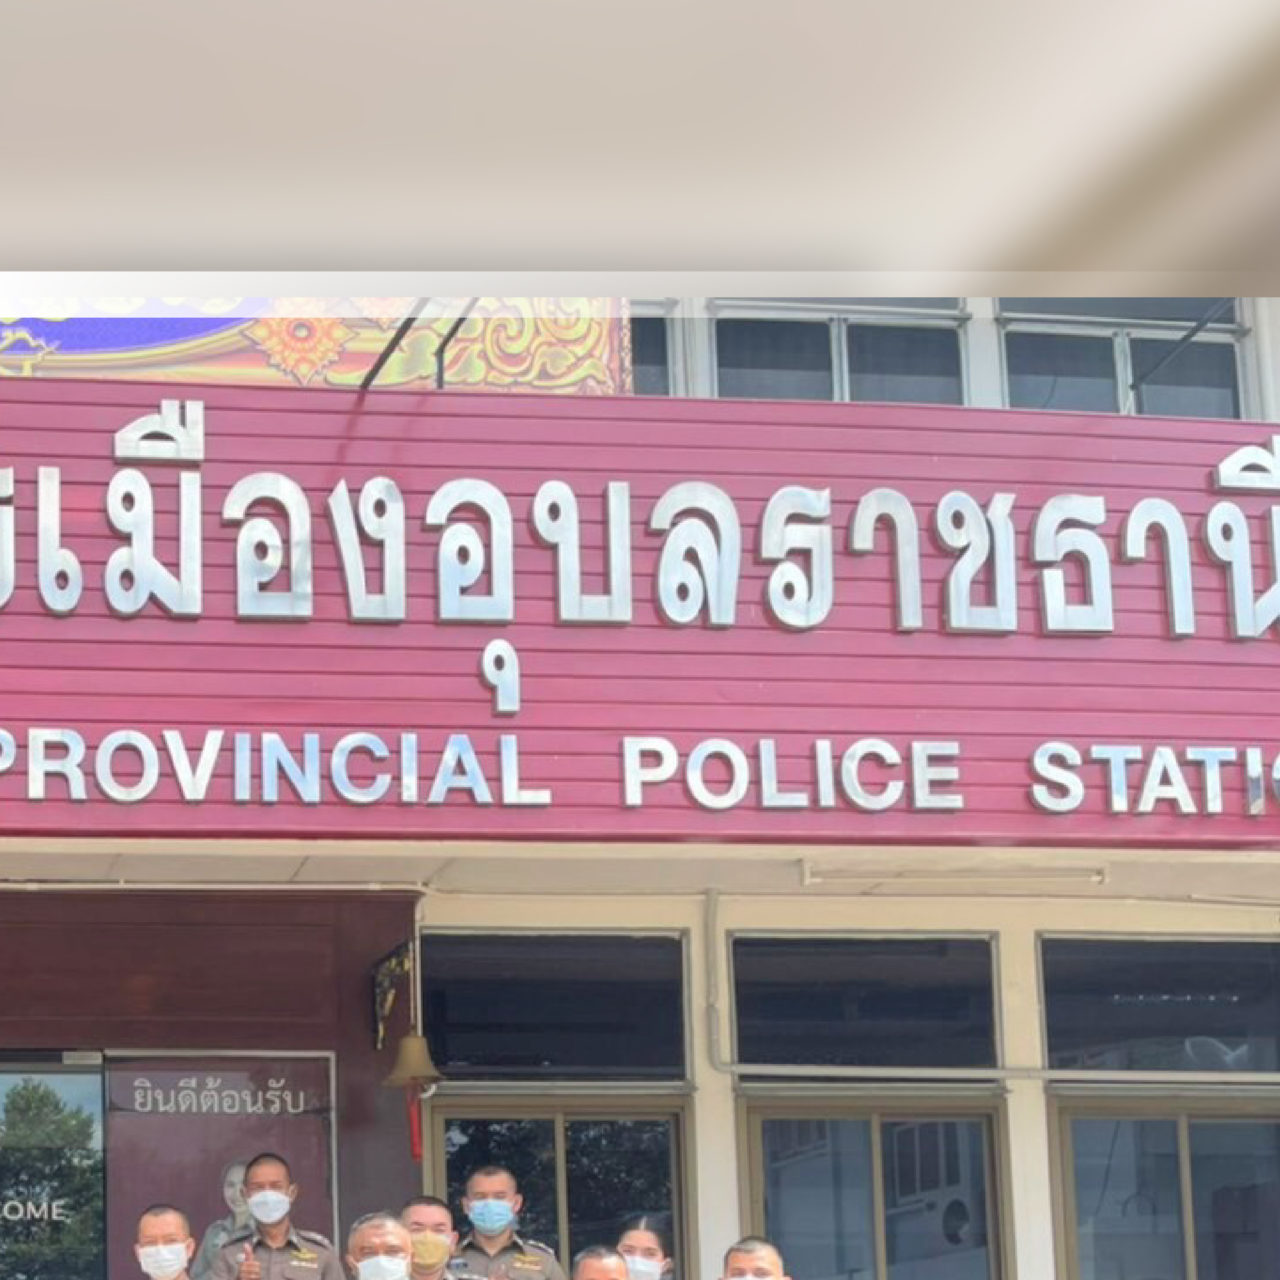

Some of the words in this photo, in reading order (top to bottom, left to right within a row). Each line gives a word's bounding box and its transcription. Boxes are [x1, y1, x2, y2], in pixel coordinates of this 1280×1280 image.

[622, 735, 965, 812] POLICE
[1030, 740, 1280, 816] STATI
[133, 1077, 305, 1114] ยินดีต้อนรับ
